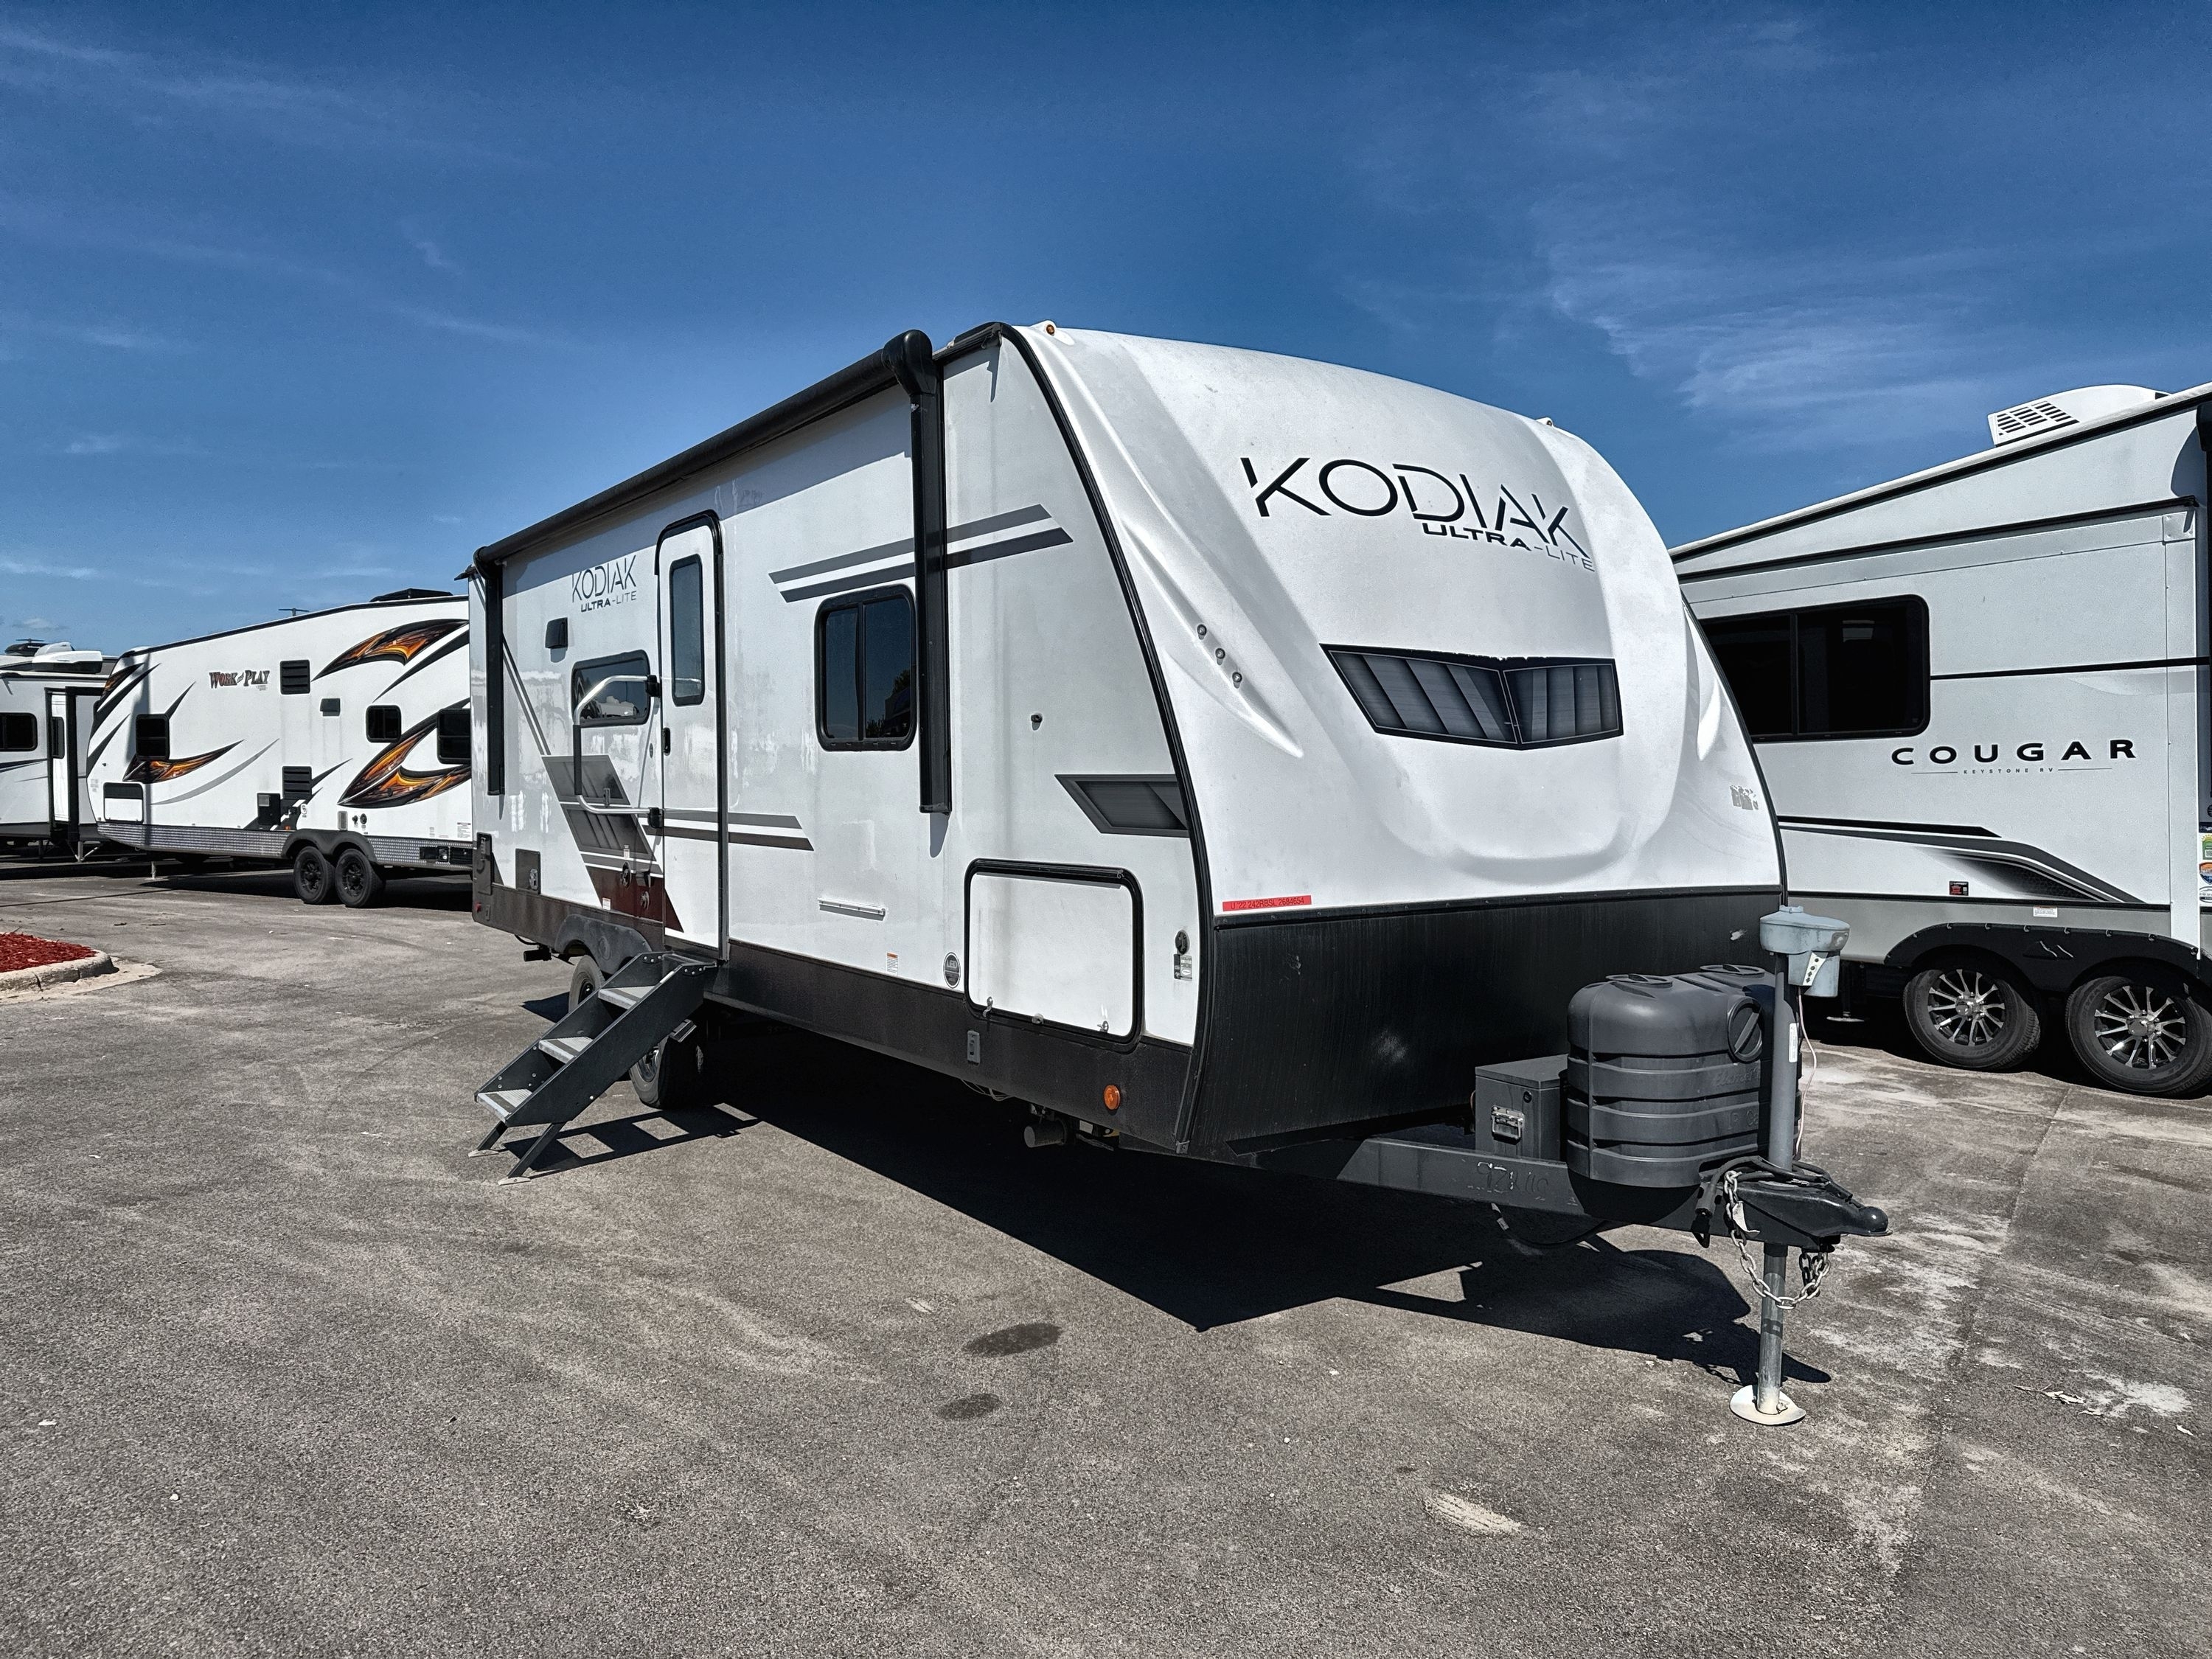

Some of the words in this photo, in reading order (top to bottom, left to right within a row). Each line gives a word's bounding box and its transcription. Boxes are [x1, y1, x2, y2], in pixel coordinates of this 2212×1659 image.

[1240, 457, 1590, 559] KODIAK
[1422, 523, 1596, 572] ULTRA-LITE
[572, 554, 636, 603] KODIAK
[581, 591, 636, 613] ULTRA-LITE
[243, 669, 270, 686] PLAY
[1891, 739, 2136, 765] COUGAR
